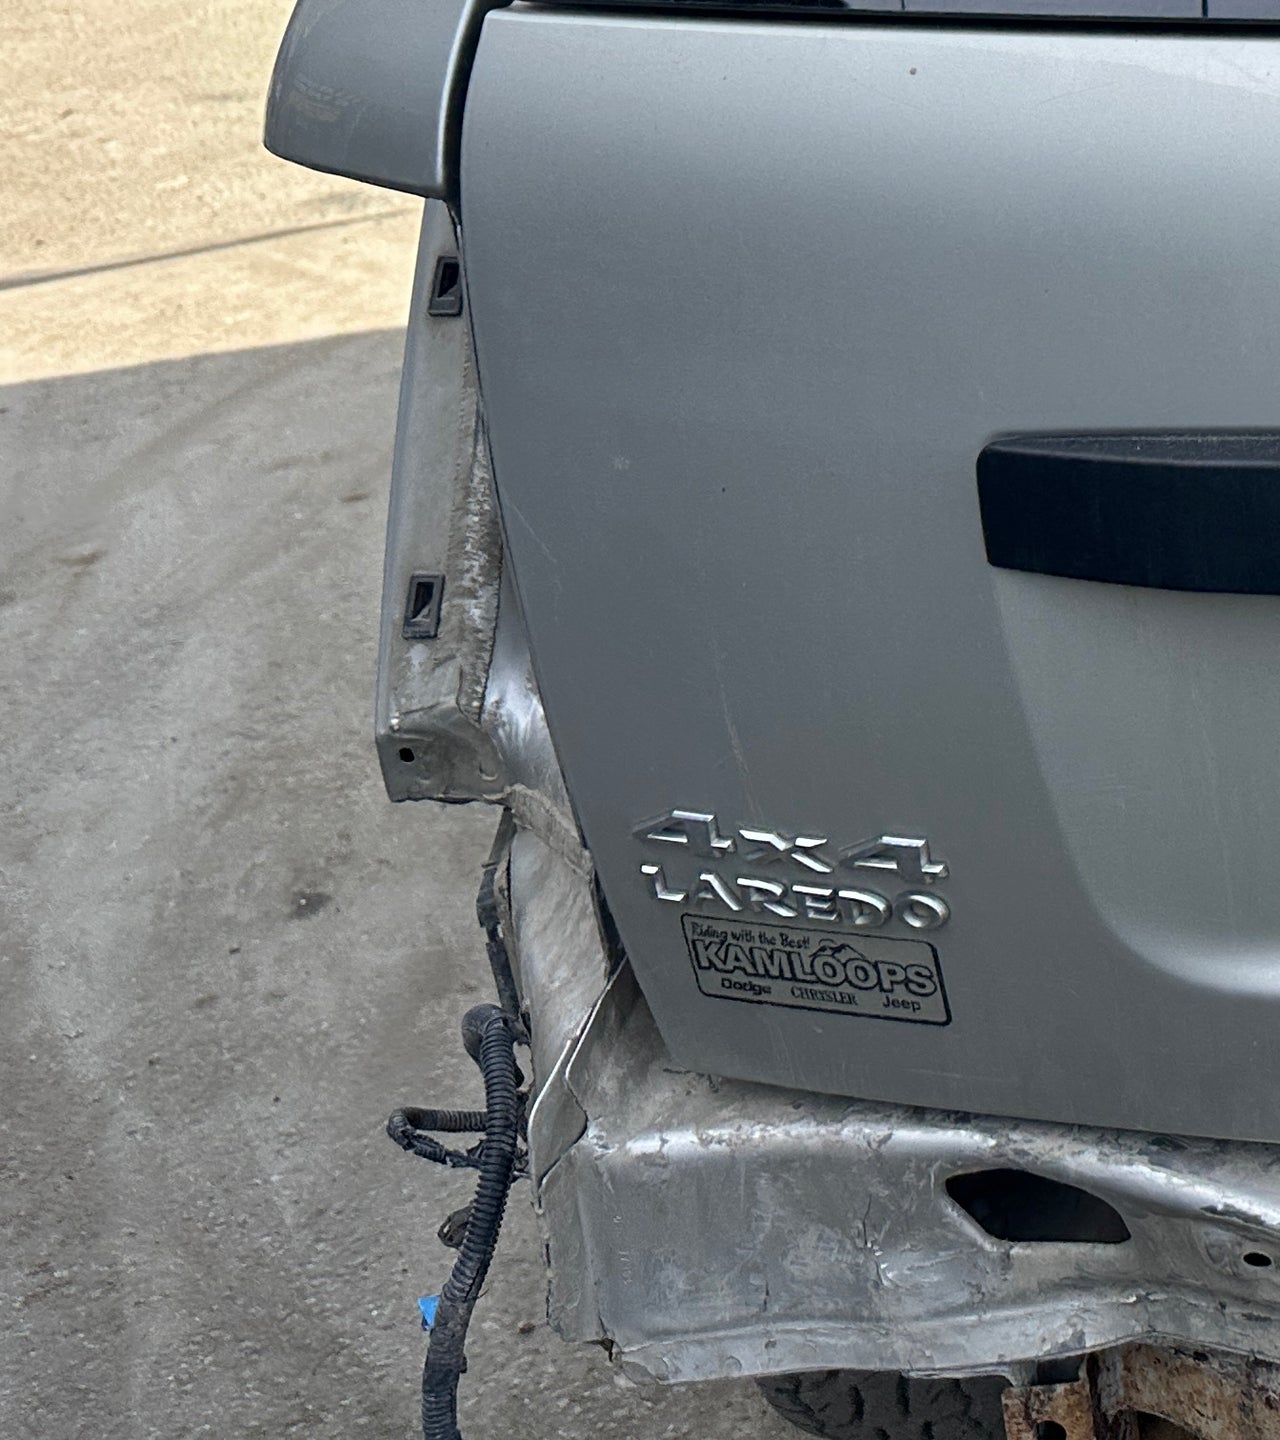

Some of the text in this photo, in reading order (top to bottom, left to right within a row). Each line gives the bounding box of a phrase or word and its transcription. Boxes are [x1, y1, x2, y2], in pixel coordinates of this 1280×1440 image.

[640, 863, 949, 929] LAREDO
[691, 922, 728, 943] Riding
[731, 931, 756, 944] with
[758, 932, 777, 946] the
[691, 939, 938, 997] KAMLOOPS
[721, 978, 921, 1012] Dodge CHRYSLER Jeep
